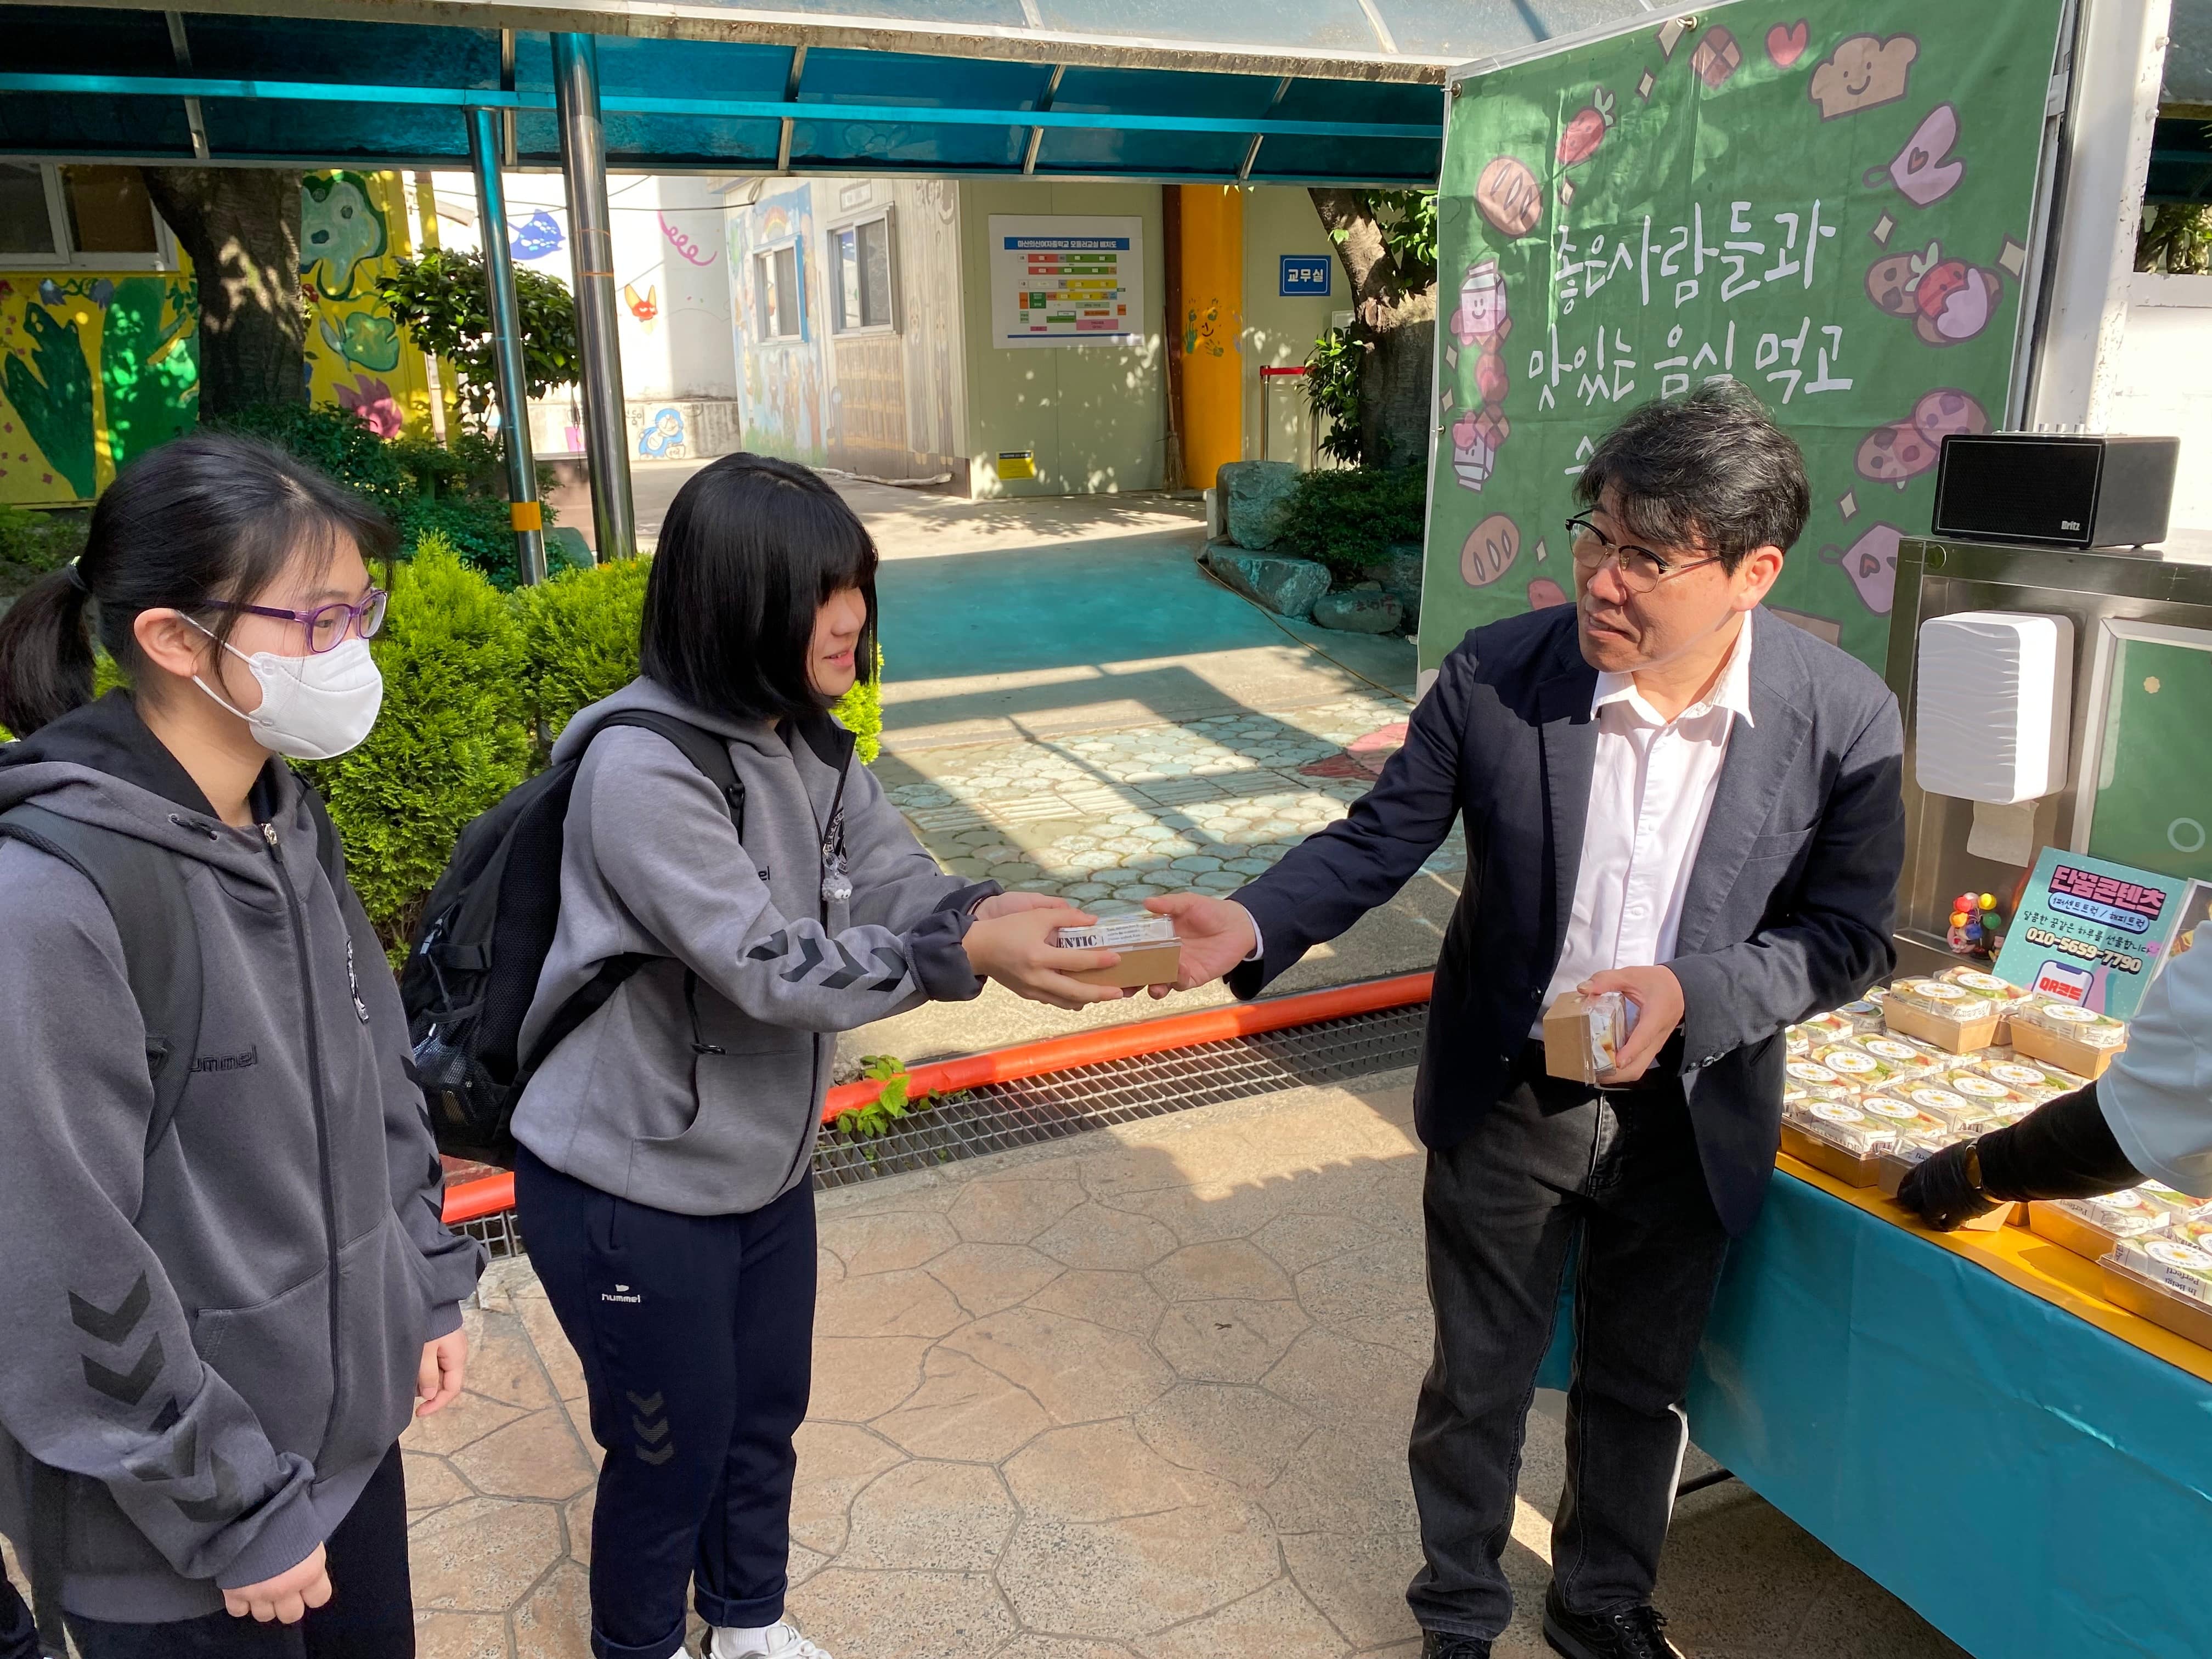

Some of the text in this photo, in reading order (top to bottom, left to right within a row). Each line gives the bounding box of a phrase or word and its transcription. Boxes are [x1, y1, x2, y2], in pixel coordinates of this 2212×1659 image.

[1288, 269, 1323, 283] 교무실
[1528, 317, 1853, 411] 맛있는 음식 먹고
[2061, 521, 2080, 531] Britz
[2049, 865, 2166, 919] 단꿈콘텐츠
[2052, 897, 2099, 917] 1퍼센트트럭
[2109, 912, 2145, 928] 해피트럭
[1056, 935, 1097, 948] ENTIC
[2023, 911, 2151, 954] 달콤한 꿈같은 하루를 선물합니다
[2025, 927, 2143, 974] 010-5659-7790
[2039, 977, 2083, 1001] QR코드
[190, 1045, 257, 1073] ummel
[601, 1293, 641, 1303] hummel
